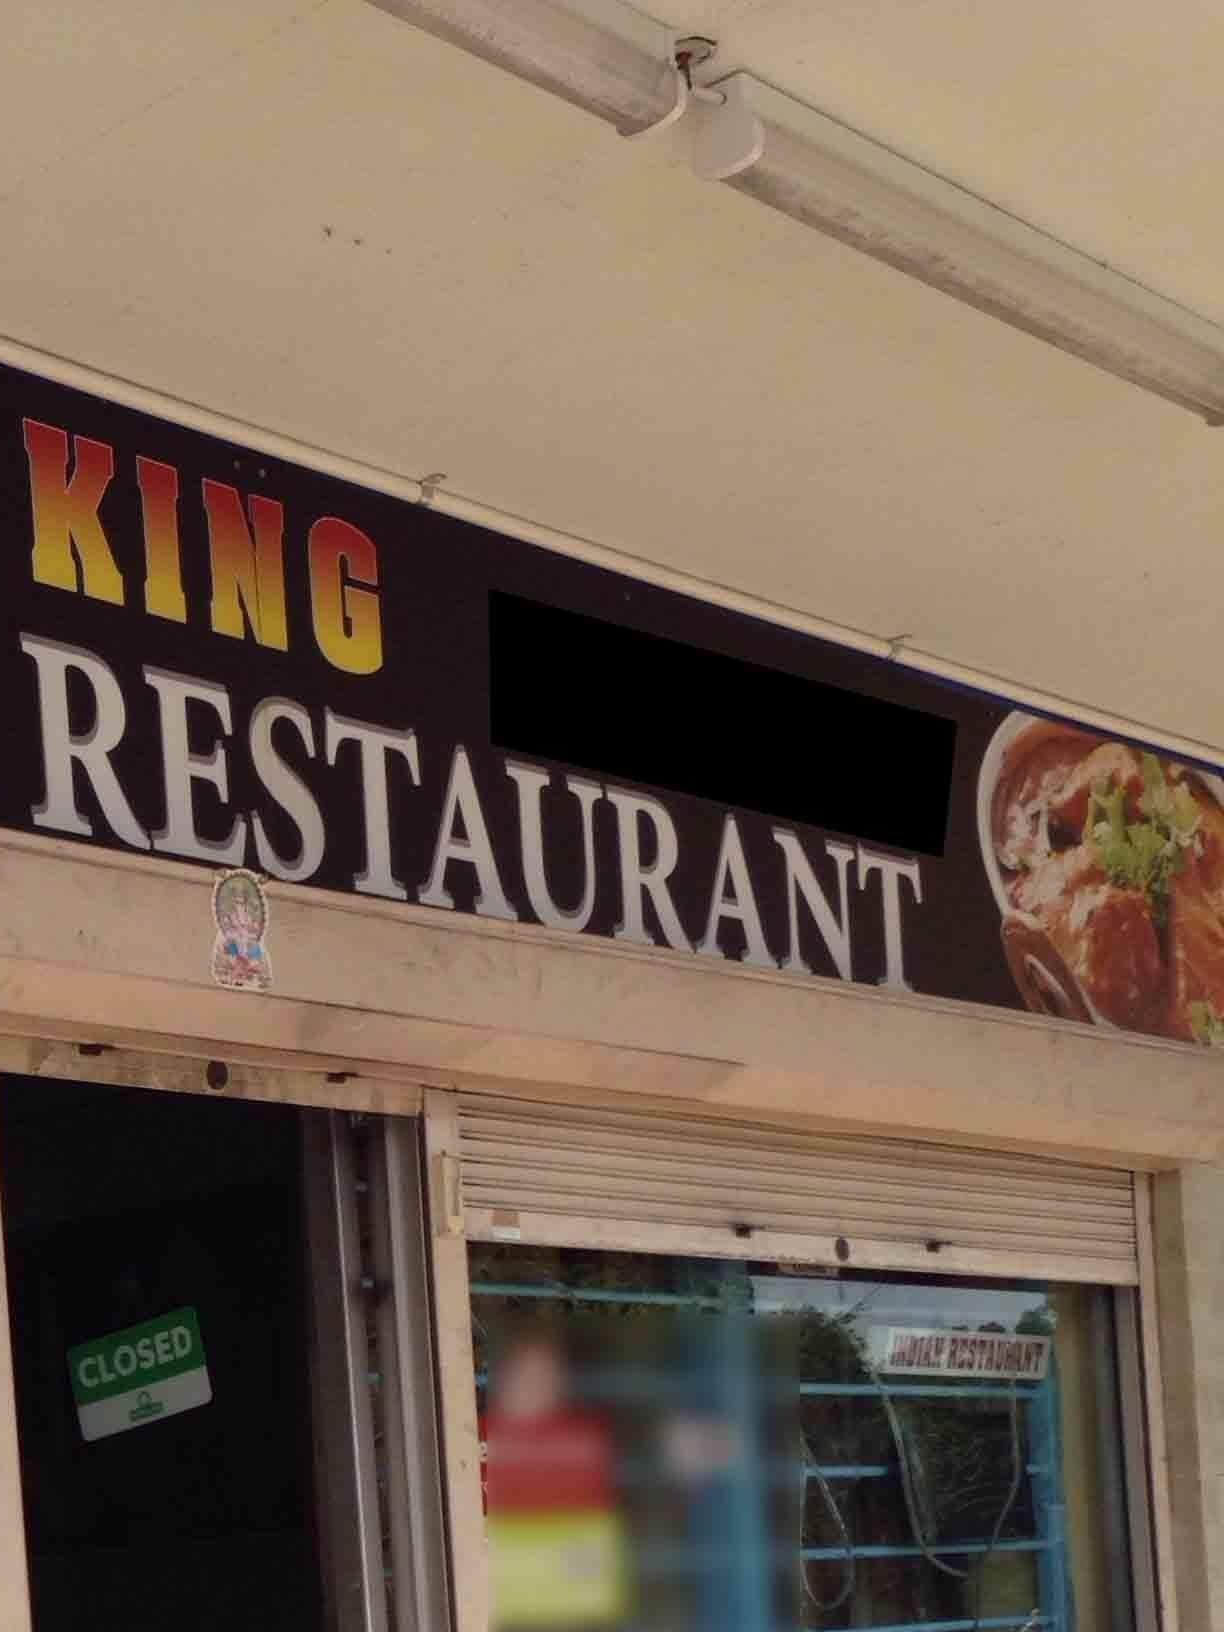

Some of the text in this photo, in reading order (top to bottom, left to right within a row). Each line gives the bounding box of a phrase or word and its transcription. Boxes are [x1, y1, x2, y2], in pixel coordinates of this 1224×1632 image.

[22, 417, 383, 676] KING
[20, 629, 924, 994] RESTAURANT
[78, 1325, 193, 1389] CLOSED
[946, 1336, 1044, 1373] RESTAURANT
